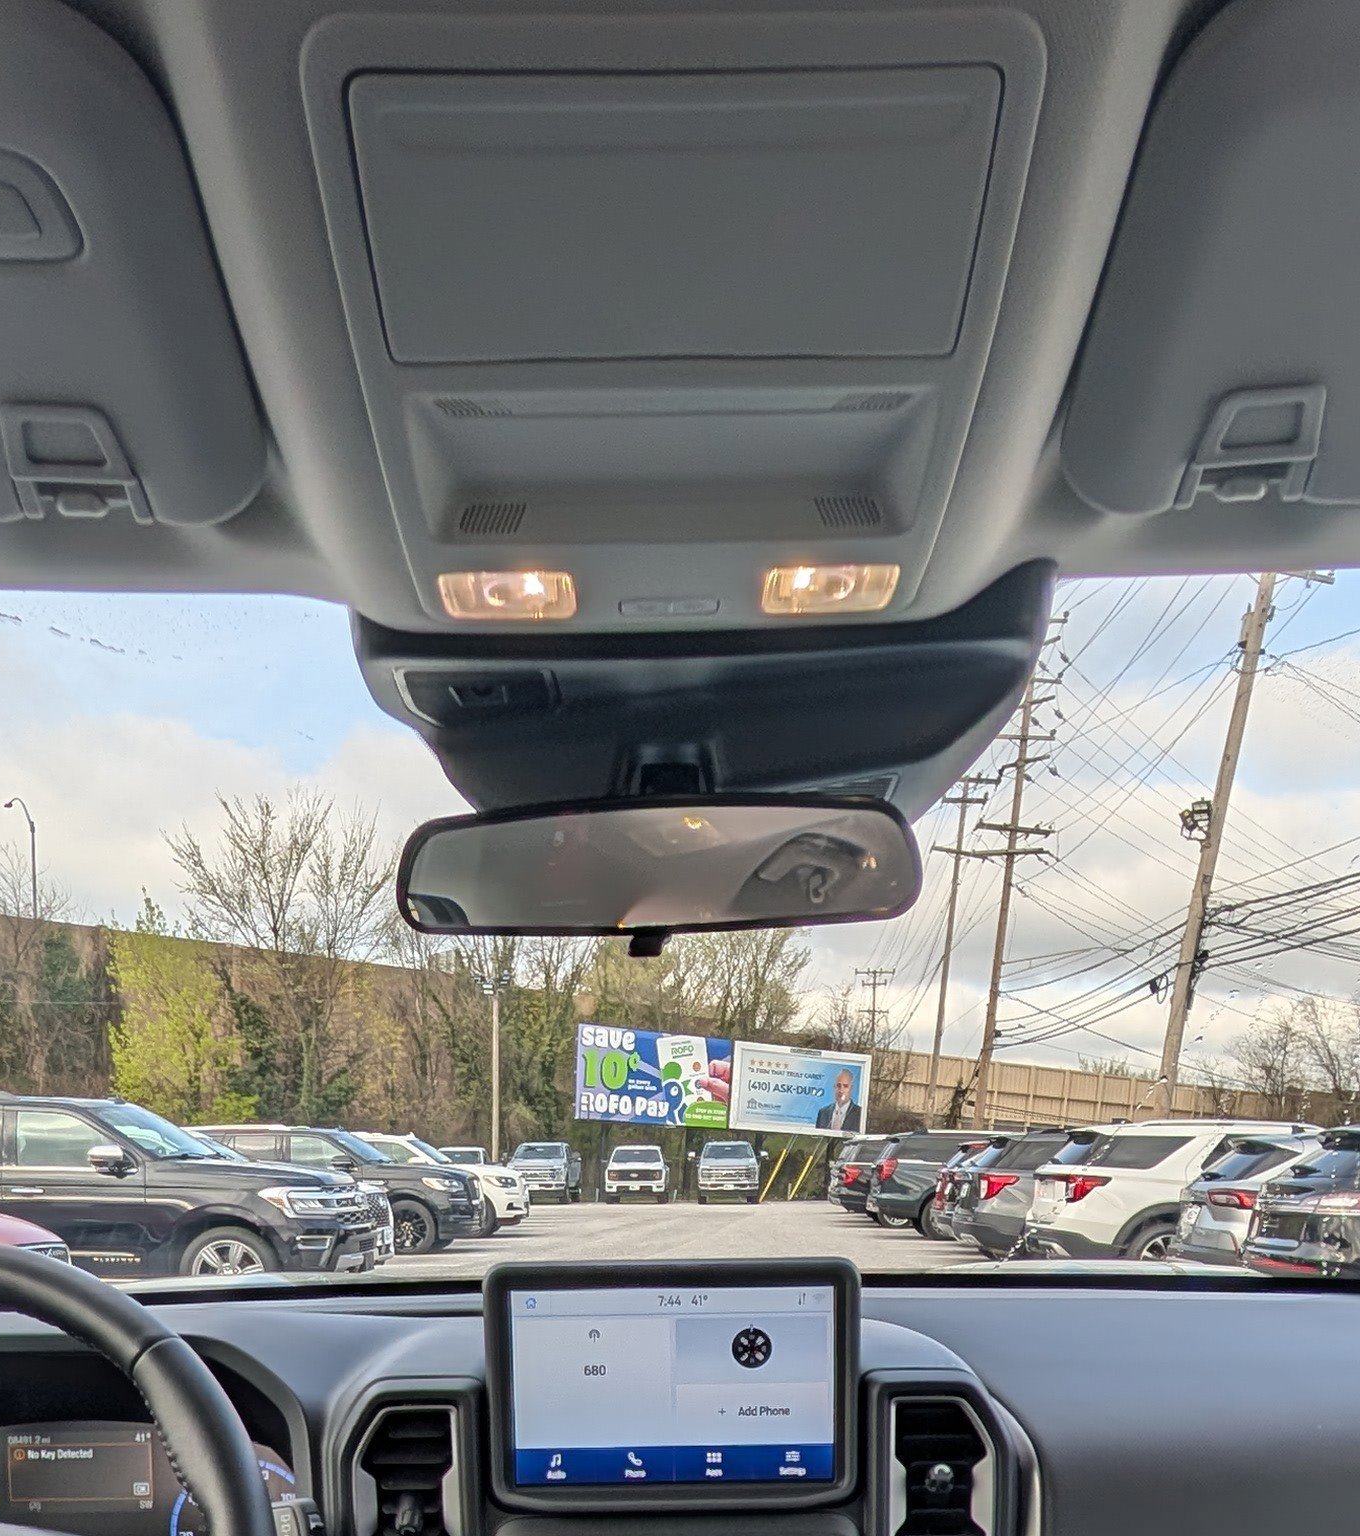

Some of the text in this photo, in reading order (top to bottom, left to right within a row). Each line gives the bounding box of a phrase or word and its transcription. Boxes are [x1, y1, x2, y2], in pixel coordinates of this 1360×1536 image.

[748, 1079, 771, 1092] (410)
[581, 1091, 670, 1118] ROFO Pay
[657, 1294, 709, 1307] 7:44 41°
[583, 1364, 607, 1377] 680
[738, 1405, 791, 1417] Add Phone
[135, 1433, 151, 1443] 41°
[27, 1448, 94, 1461] No Key Detected
